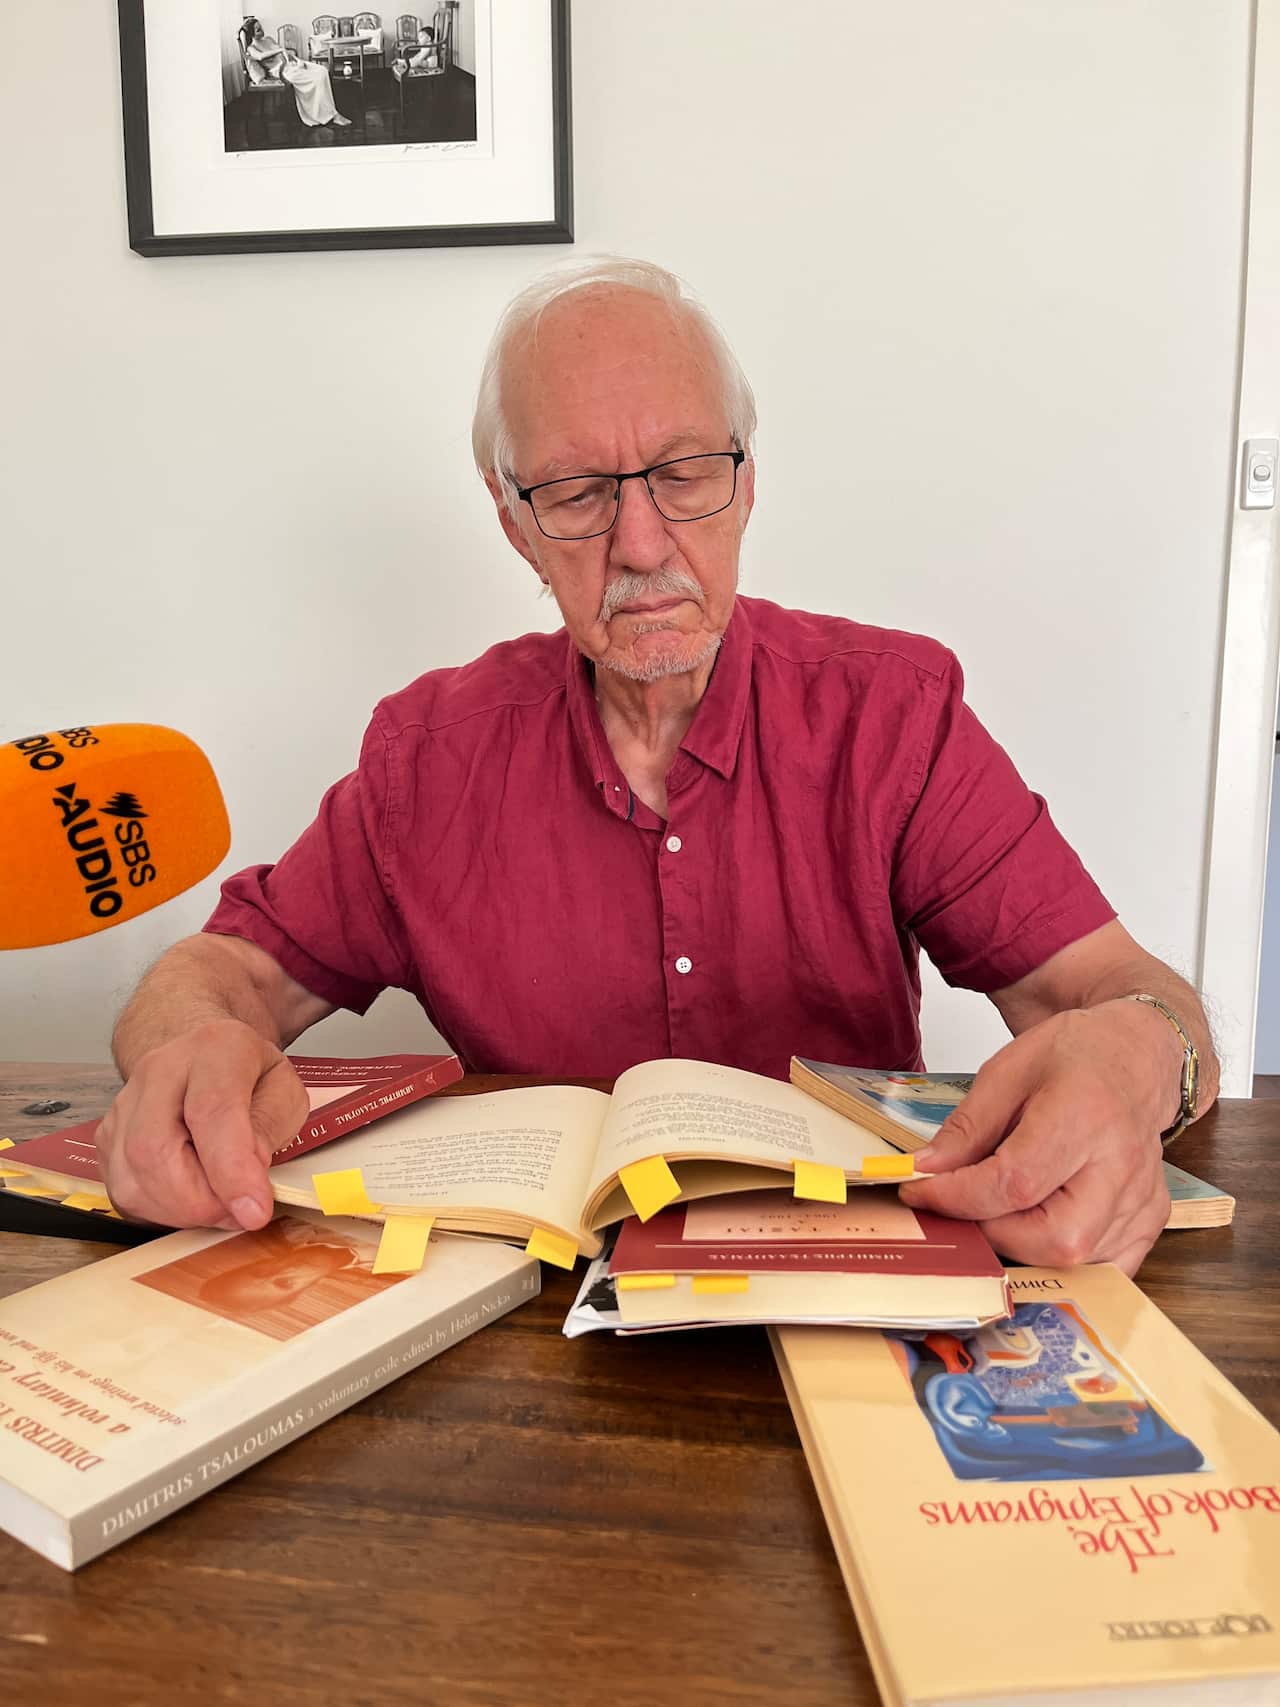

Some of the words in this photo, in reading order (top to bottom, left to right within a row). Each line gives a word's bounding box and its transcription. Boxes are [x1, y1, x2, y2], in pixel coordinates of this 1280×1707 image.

[11, 734, 64, 771] DIO
[52, 798, 123, 918] AUDIO
[115, 820, 156, 887] SBS
[12, 1371, 110, 1424] voluntary
[89, 1377, 140, 1403] writings
[131, 1401, 187, 1425] selected
[5, 1415, 104, 1472] DIMITRIS
[102, 1472, 193, 1538] DIMITRIS
[198, 1409, 304, 1482] TSALOUMAS
[318, 1373, 372, 1412] voluntary
[374, 1355, 400, 1378] exile
[402, 1333, 433, 1363] edited
[435, 1322, 448, 1346] by
[450, 1309, 479, 1334] Helen
[108, 1423, 131, 1433] a
[919, 1487, 1138, 1532] Epigrams
[1130, 1485, 1174, 1536] of
[1168, 1485, 1280, 1533] Book
[1072, 1519, 1176, 1574] The
[1104, 1618, 1200, 1641] POETRY
[1209, 1613, 1274, 1639] UQP
